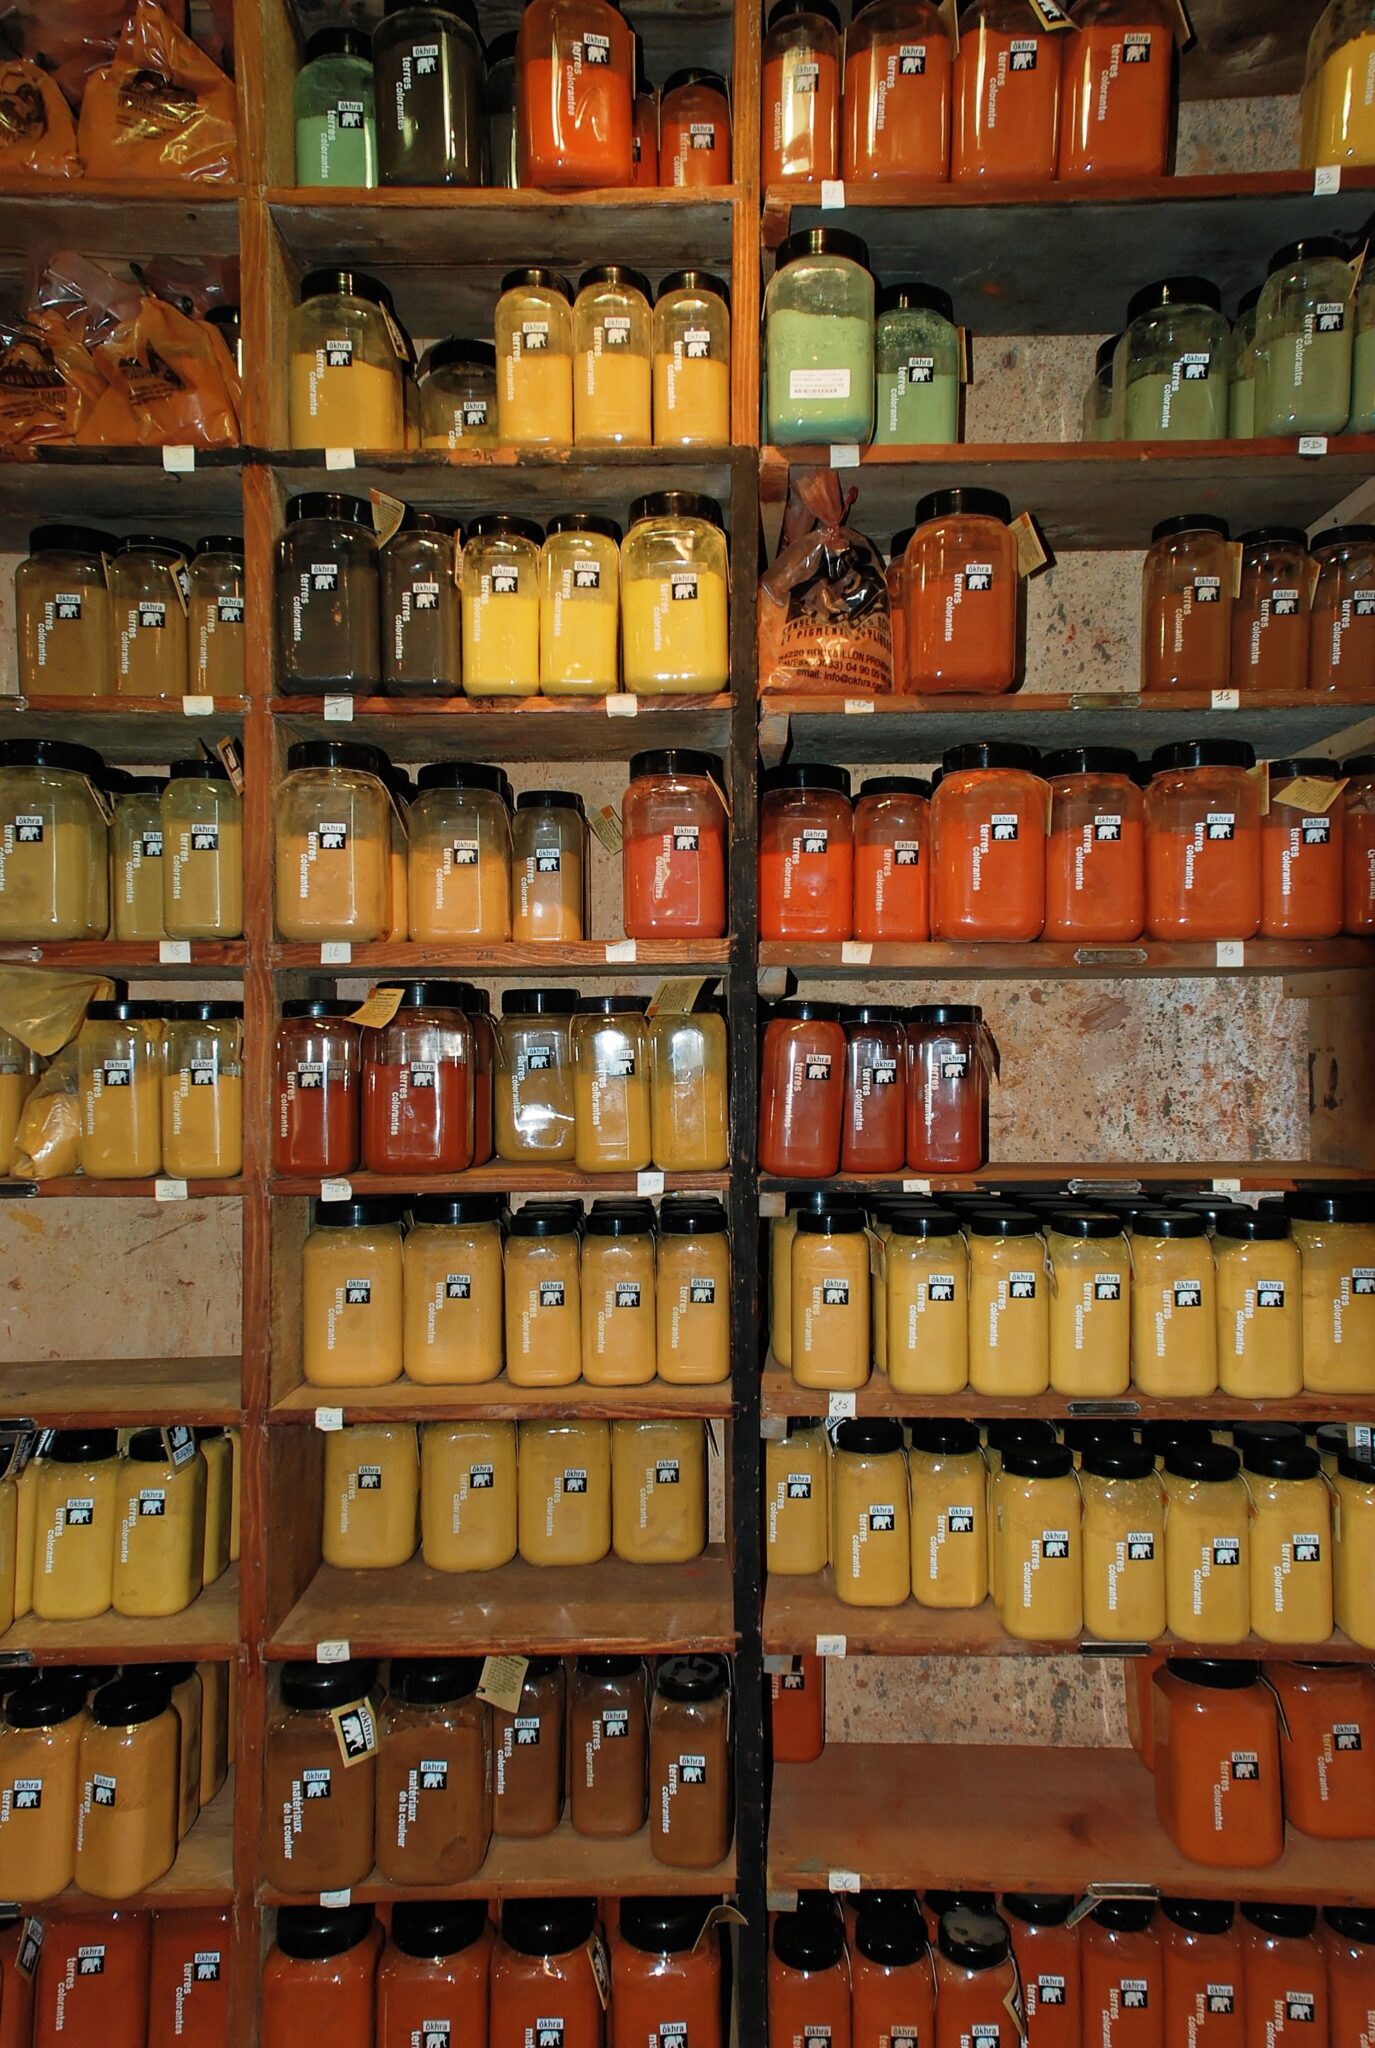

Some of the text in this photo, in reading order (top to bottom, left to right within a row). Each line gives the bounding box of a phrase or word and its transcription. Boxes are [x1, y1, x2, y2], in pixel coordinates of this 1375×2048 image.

[403, 56, 411, 89] terres
[573, 42, 583, 75] terres
[887, 55, 897, 89] terres
[1110, 43, 1122, 78] terres
[396, 82, 404, 130] colorantes
[567, 65, 575, 116] colorantes
[877, 80, 887, 130] colorantes
[1098, 70, 1110, 121] colorantes
[327, 110, 336, 141] terres
[321, 133, 330, 179] colorantes
[1304, 314, 1314, 345] terres
[316, 349, 326, 379] terres
[1171, 361, 1182, 392] terres
[1294, 338, 1304, 386] colorantes
[309, 371, 317, 416] colorantes
[898, 366, 908, 396] terres
[890, 388, 898, 432] colorantes
[1162, 384, 1172, 428] colorantes
[300, 573, 311, 604] terres
[954, 573, 964, 604] terres
[1183, 586, 1193, 616] terres
[45, 602, 55, 631] terres
[293, 595, 303, 641] colorantes
[402, 591, 412, 622] terres
[944, 596, 955, 642] colorantes
[1261, 599, 1272, 628] terres
[37, 623, 47, 666] colorantes
[395, 614, 404, 660] colorantes
[1174, 608, 1184, 653] colorantes
[1251, 621, 1261, 664] colorantes
[4, 824, 15, 854] terres
[180, 832, 190, 862] terres
[308, 831, 319, 861] terres
[792, 837, 802, 865] terres
[980, 823, 990, 854] terres
[1195, 822, 1206, 853] terres
[1290, 827, 1301, 858] terres
[173, 855, 182, 899] colorantes
[300, 853, 310, 898] colorantes
[783, 857, 792, 899] colorantes
[884, 848, 893, 877] terres
[972, 846, 981, 891] colorantes
[1185, 845, 1195, 889] colorantes
[1282, 850, 1292, 895] colorantes
[875, 869, 884, 912] colorantes
[287, 1071, 297, 1101] terres
[400, 1070, 409, 1099] terres
[862, 1068, 873, 1097] terres
[281, 1093, 289, 1138] colorantes
[391, 1091, 400, 1136] colorantes
[855, 1089, 864, 1131] colorantes
[336, 1287, 345, 1315] terres
[679, 1286, 689, 1314] terres
[917, 1283, 927, 1312] terres
[1083, 1282, 1094, 1312] terres
[1244, 1289, 1256, 1319] terres
[328, 1308, 336, 1350] colorantes
[672, 1306, 680, 1349] colorantes
[908, 1305, 918, 1349] colorantes
[1075, 1305, 1084, 1349] colorantes
[1235, 1310, 1245, 1355] colorantes
[55, 1508, 65, 1537] terres
[859, 1514, 868, 1542] terres
[45, 1530, 56, 1574] colorantes
[852, 1535, 861, 1578] colorantes
[1032, 1540, 1042, 1570] terres
[1023, 1561, 1032, 1608] colorantes
[504, 1727, 514, 1758] terres
[497, 1750, 505, 1795] colorantes
[669, 1764, 679, 1795] terres
[1220, 1760, 1230, 1792] terres
[662, 1786, 671, 1833] colorantes
[1214, 1784, 1223, 1831] colorantes
[284, 1826, 294, 1859] couleur
[398, 1814, 407, 1847] couleur
[66, 1957, 77, 1990] terres
[183, 1962, 193, 1994] terres
[55, 1982, 66, 2031] colorantes
[175, 1987, 185, 2035] colorantes
[1109, 1989, 1119, 2020] terres
